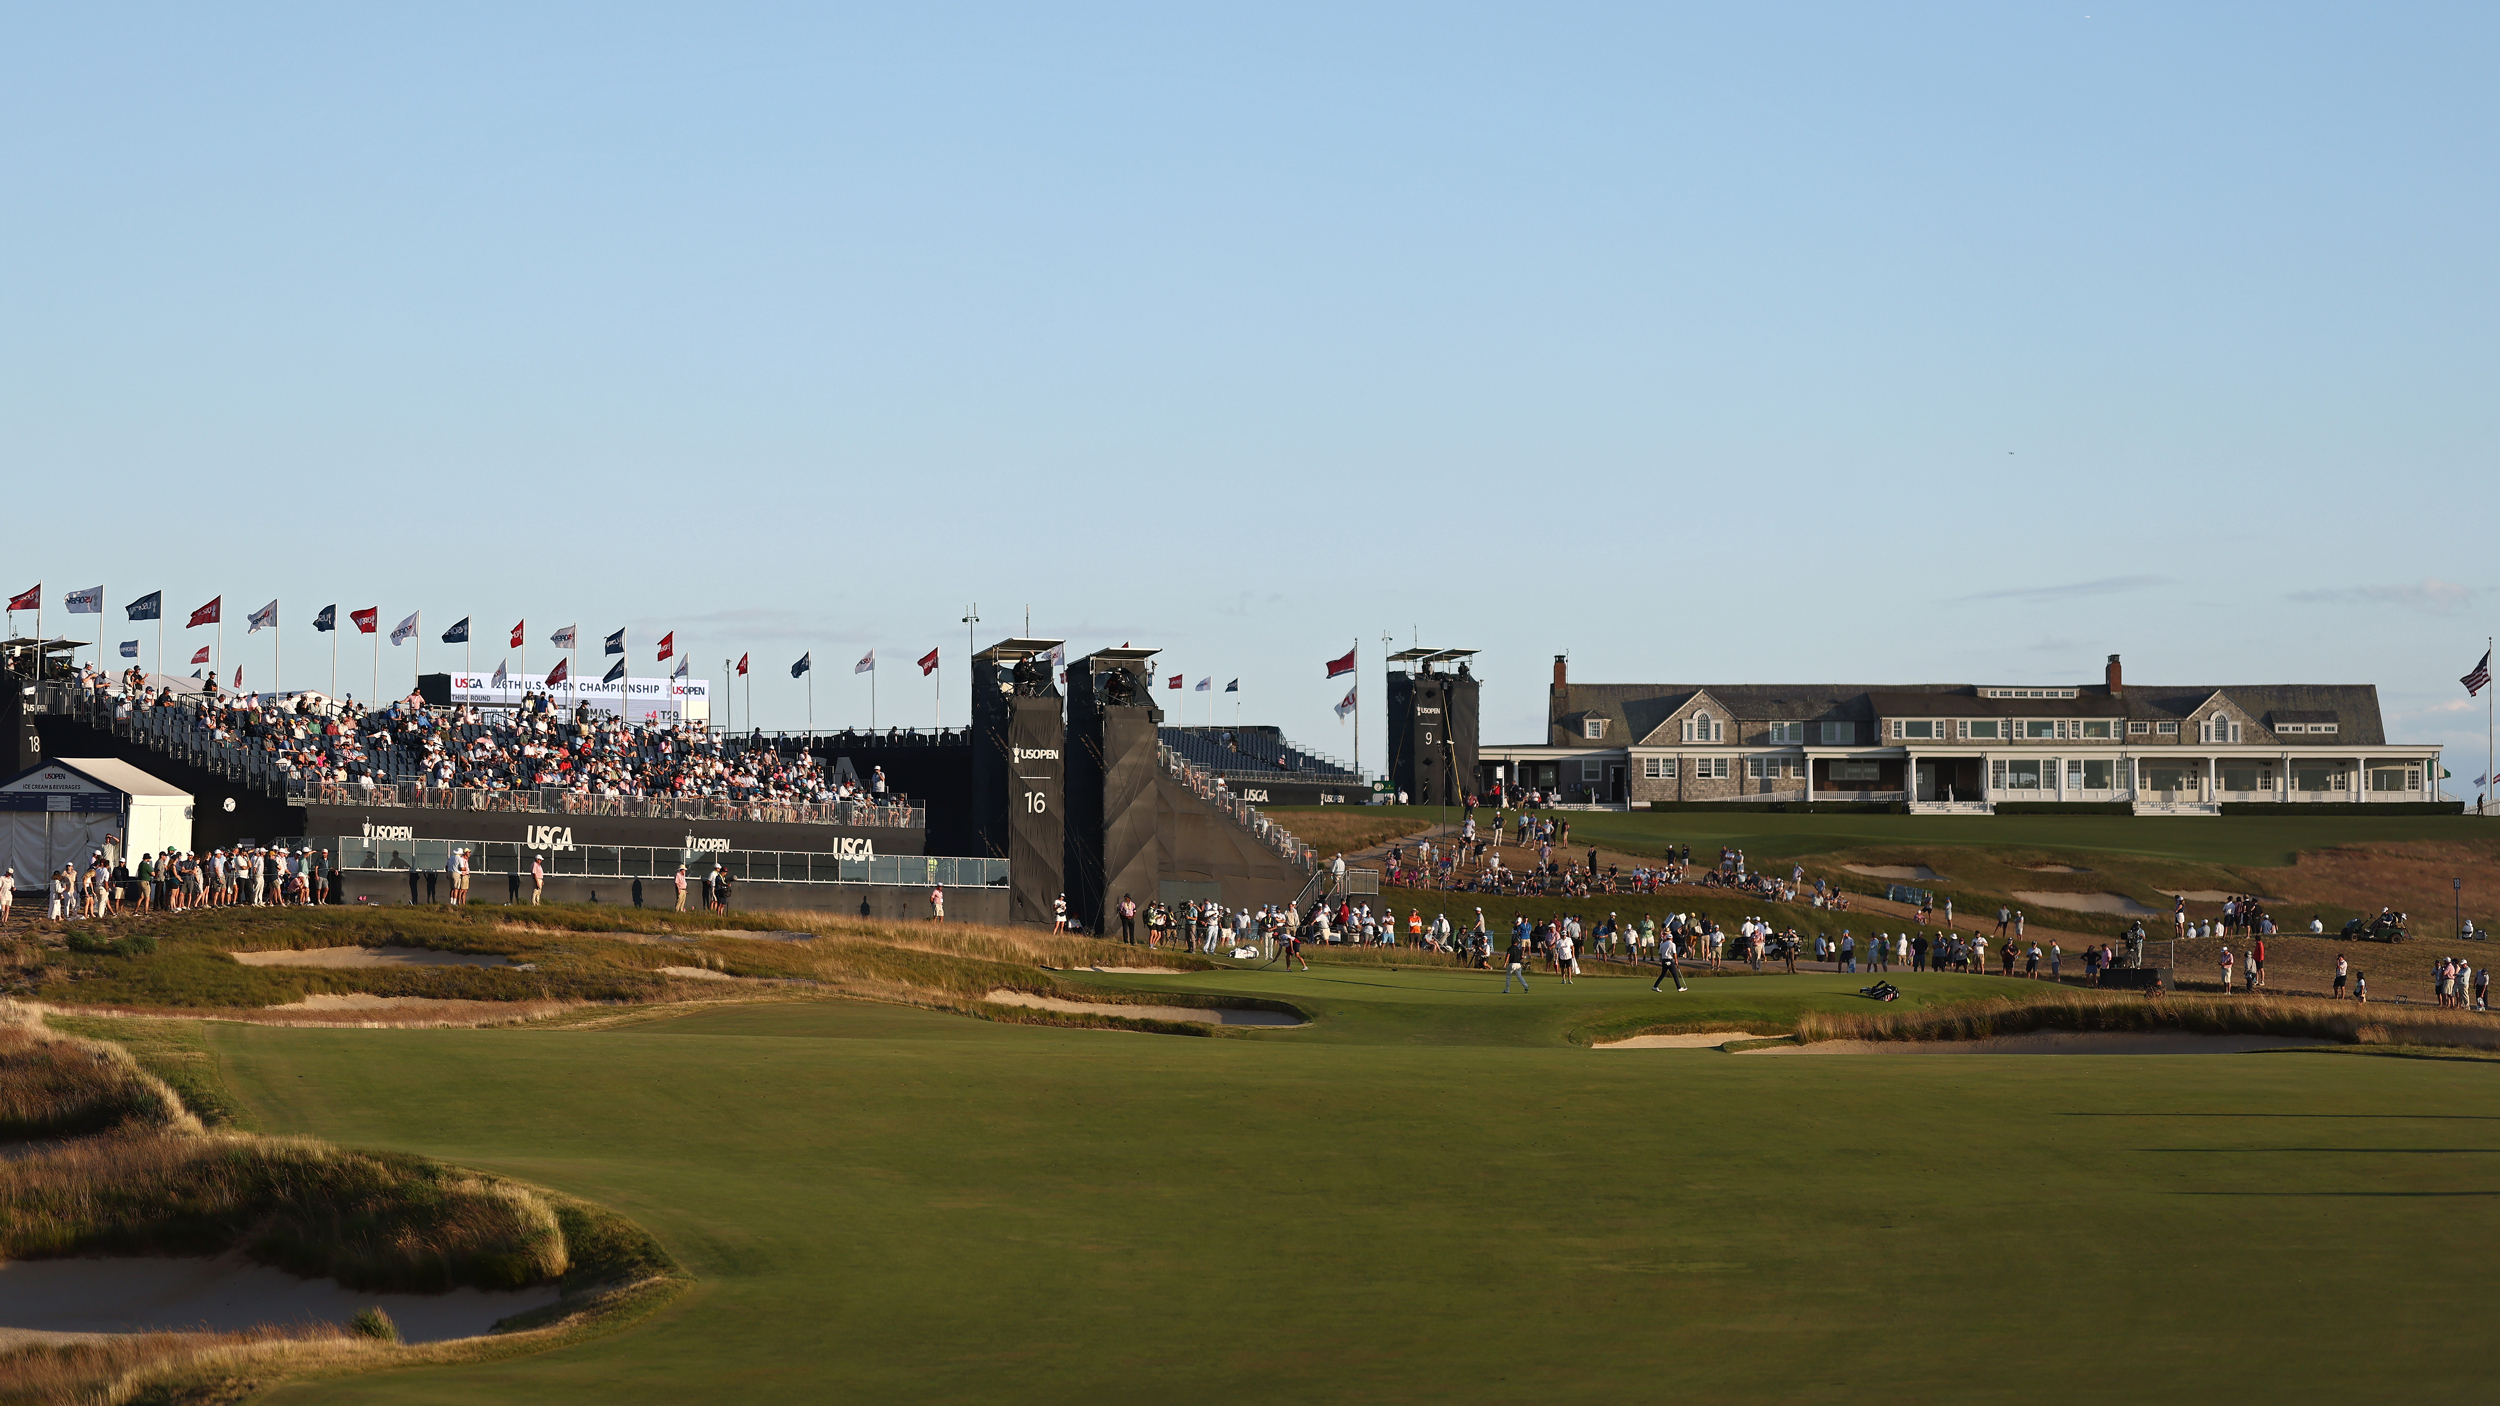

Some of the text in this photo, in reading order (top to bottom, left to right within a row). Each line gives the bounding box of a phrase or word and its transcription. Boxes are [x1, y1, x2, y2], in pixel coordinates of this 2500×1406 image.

[455, 678, 483, 688] USGA
[492, 680, 660, 693] 26TH U.S. OPEN CHAMPIONSHIP
[26, 704, 48, 712] USPEN
[645, 710, 679, 720] +4 T29
[28, 735, 40, 752] 18
[1425, 732, 1433, 745] 9
[1020, 749, 1059, 759] USOPEN
[1244, 788, 1269, 802] USGA
[1025, 792, 1046, 813] 16
[371, 825, 412, 840] USOPEN
[527, 825, 574, 851] USGA
[692, 838, 731, 852] USOPEN
[833, 837, 876, 862] USGA
